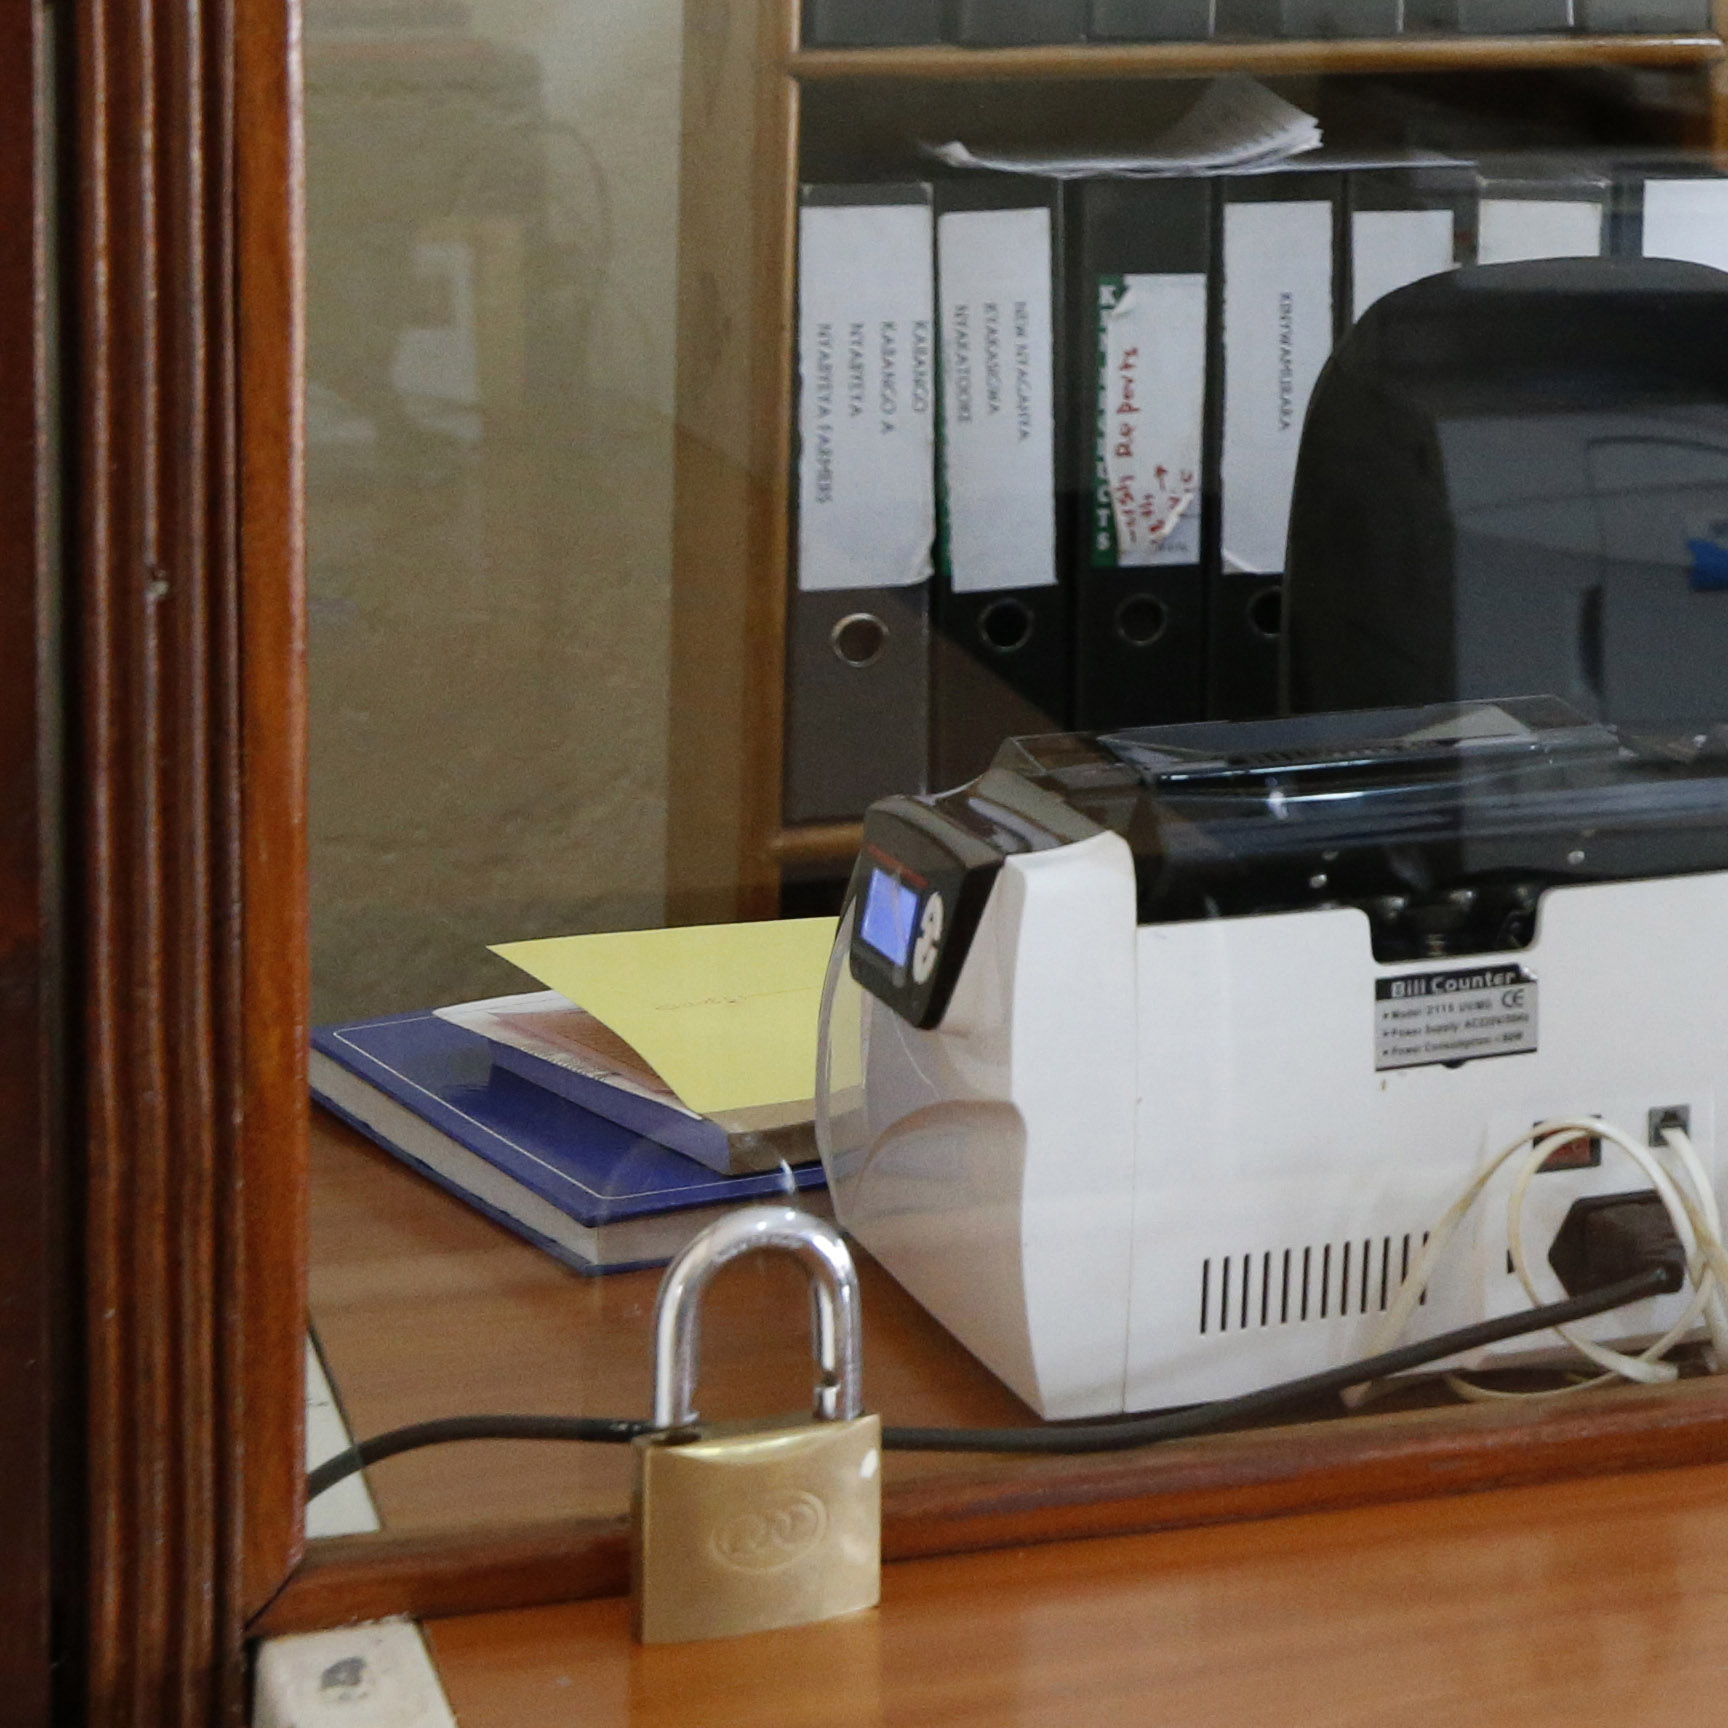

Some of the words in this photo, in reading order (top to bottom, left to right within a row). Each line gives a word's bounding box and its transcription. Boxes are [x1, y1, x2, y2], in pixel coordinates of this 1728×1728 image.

[1391, 978, 1426, 999] Bill
[1431, 971, 1517, 992] Counter
[1501, 989, 1525, 1009] CE
